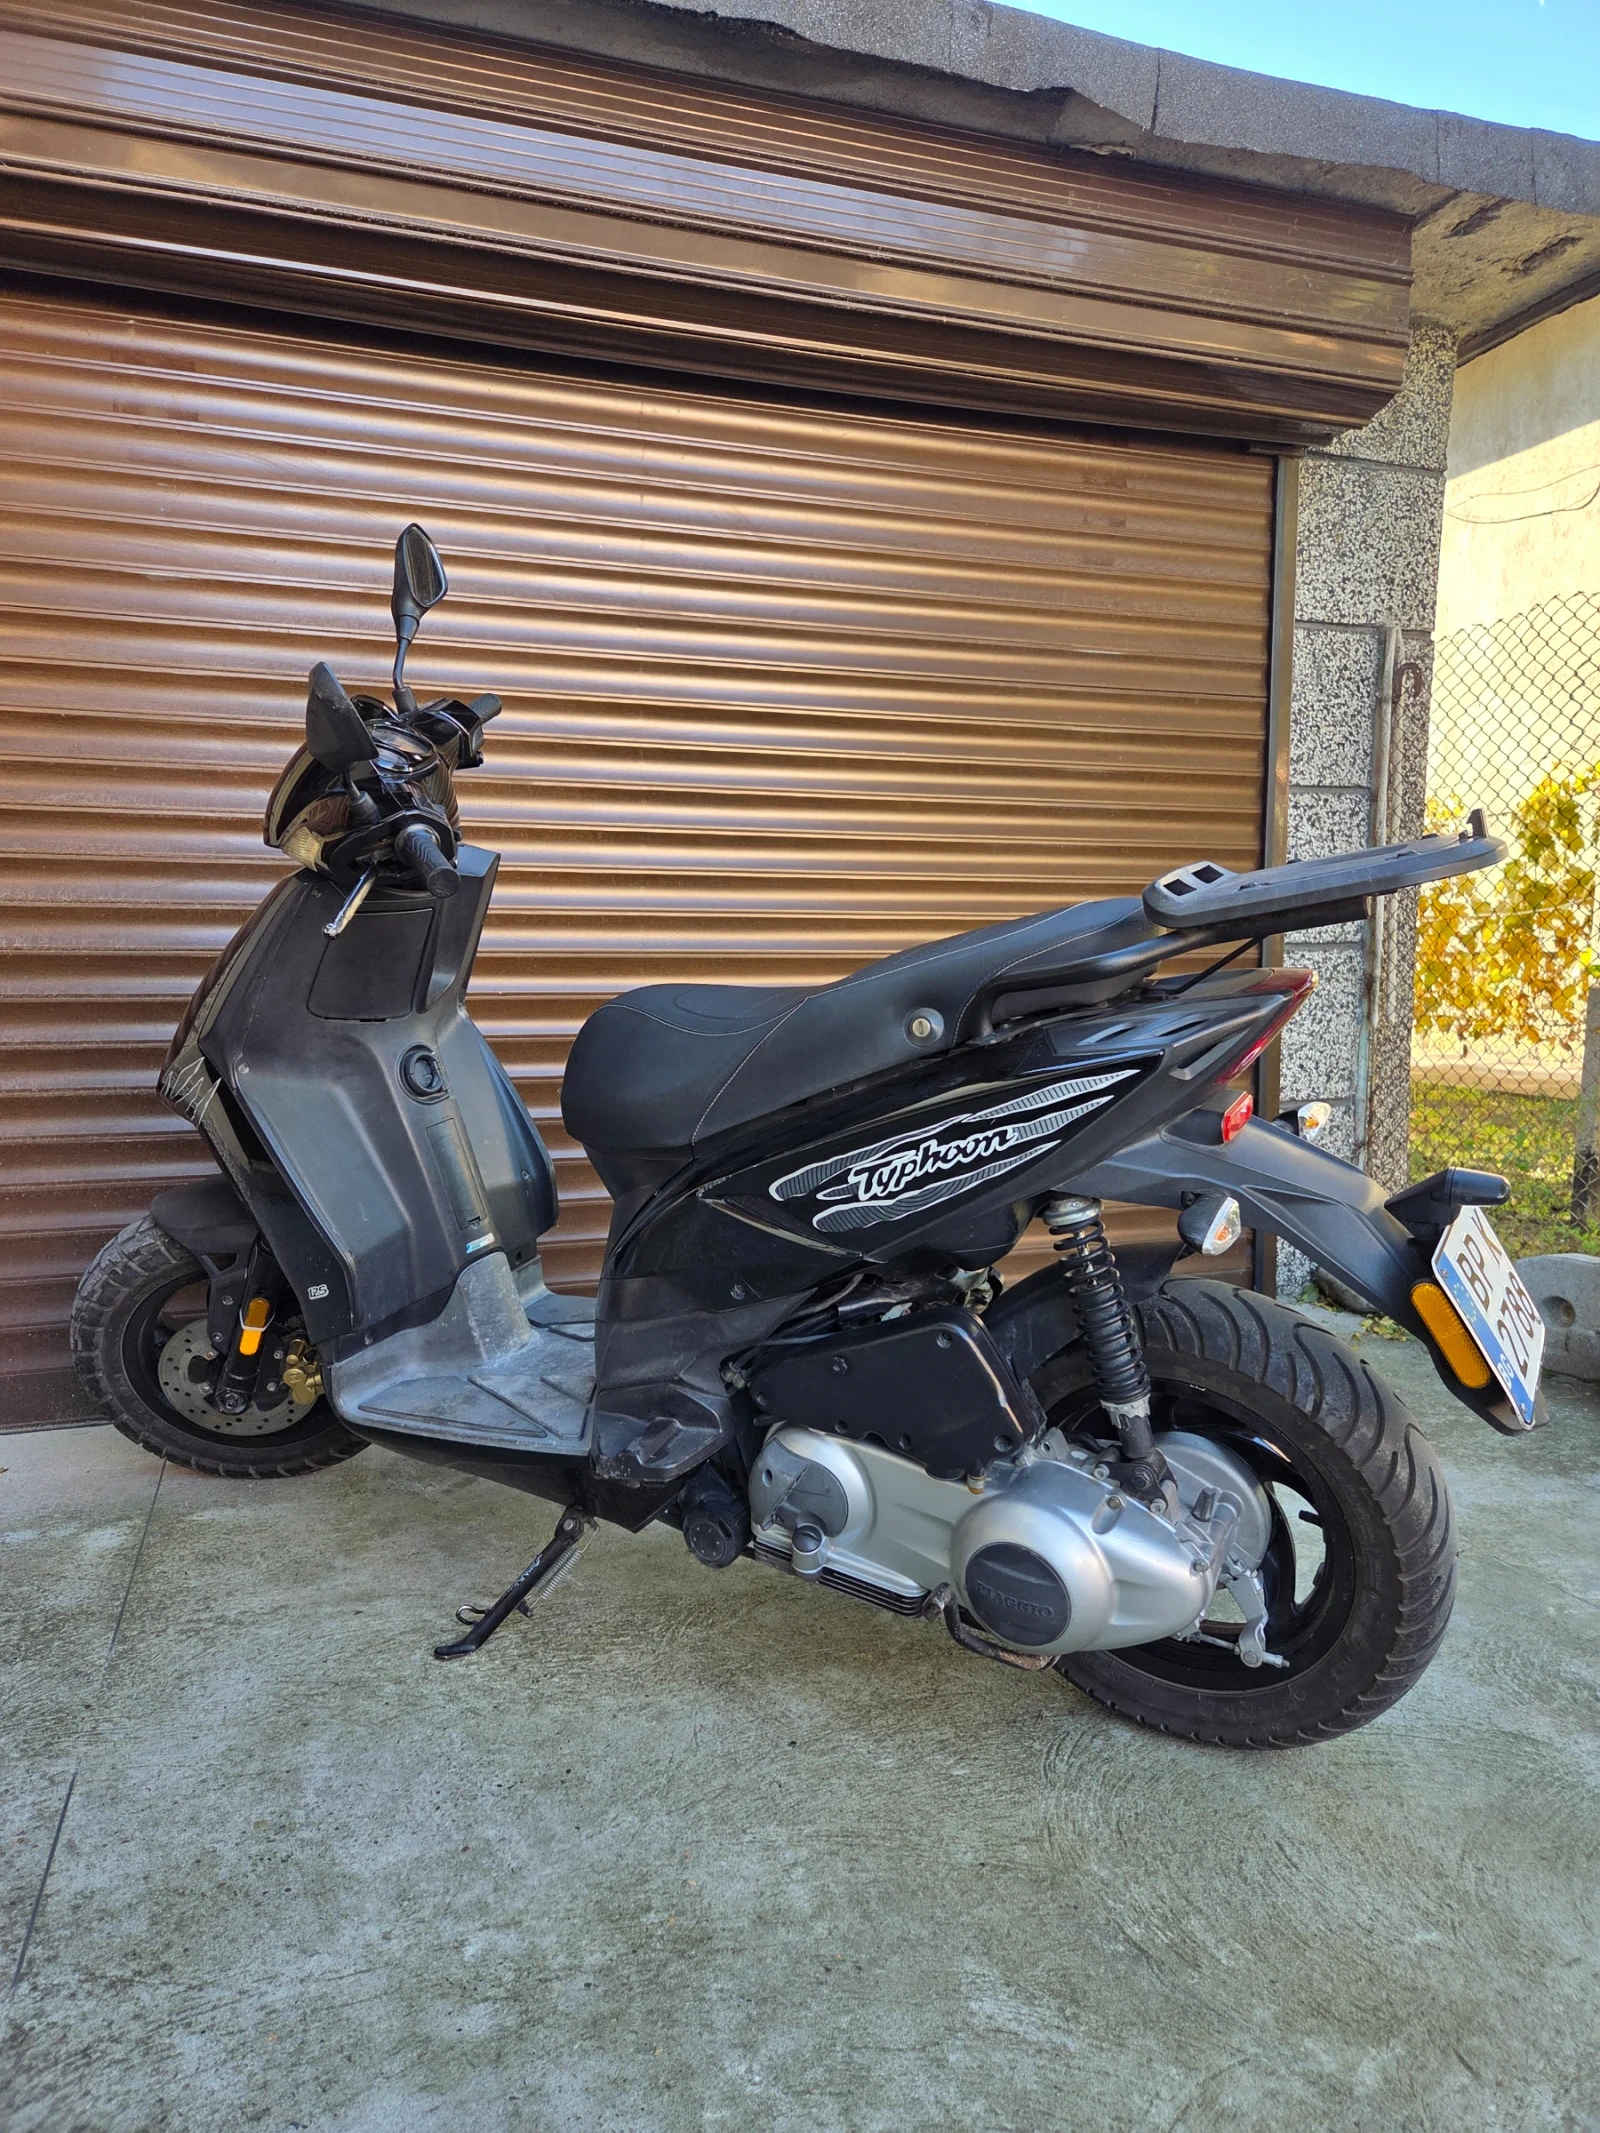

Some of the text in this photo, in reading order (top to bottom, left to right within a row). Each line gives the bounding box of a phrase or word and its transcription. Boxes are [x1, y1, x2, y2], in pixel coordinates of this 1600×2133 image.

[848, 1127, 1018, 1201] Typhoon
[309, 1285, 328, 1299] 125
[1456, 1233, 1494, 1314] BP
[1497, 1270, 1536, 1380] 2788
[1497, 1353, 1515, 1390] BG
[975, 1580, 1055, 1619] PIAGGIO
